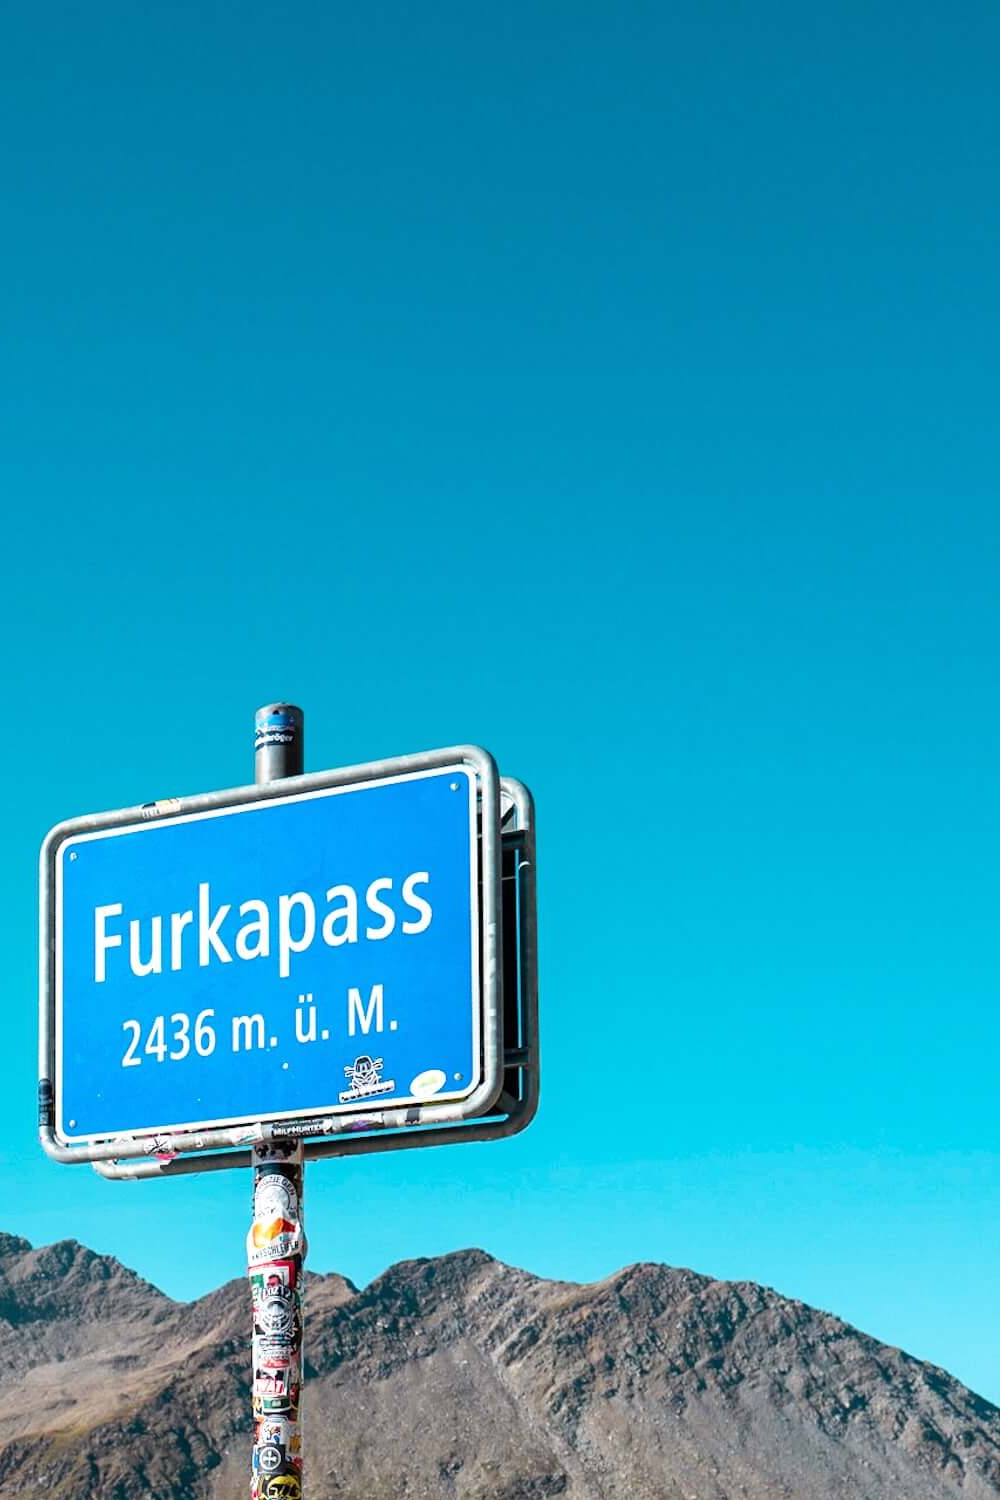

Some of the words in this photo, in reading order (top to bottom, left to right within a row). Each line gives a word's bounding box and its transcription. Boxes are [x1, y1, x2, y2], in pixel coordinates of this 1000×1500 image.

[95, 872, 433, 983] Furkapass
[122, 1008, 217, 1067] 2436
[232, 1013, 279, 1052] m.
[295, 993, 330, 1044] ü.
[348, 984, 399, 1037] M.
